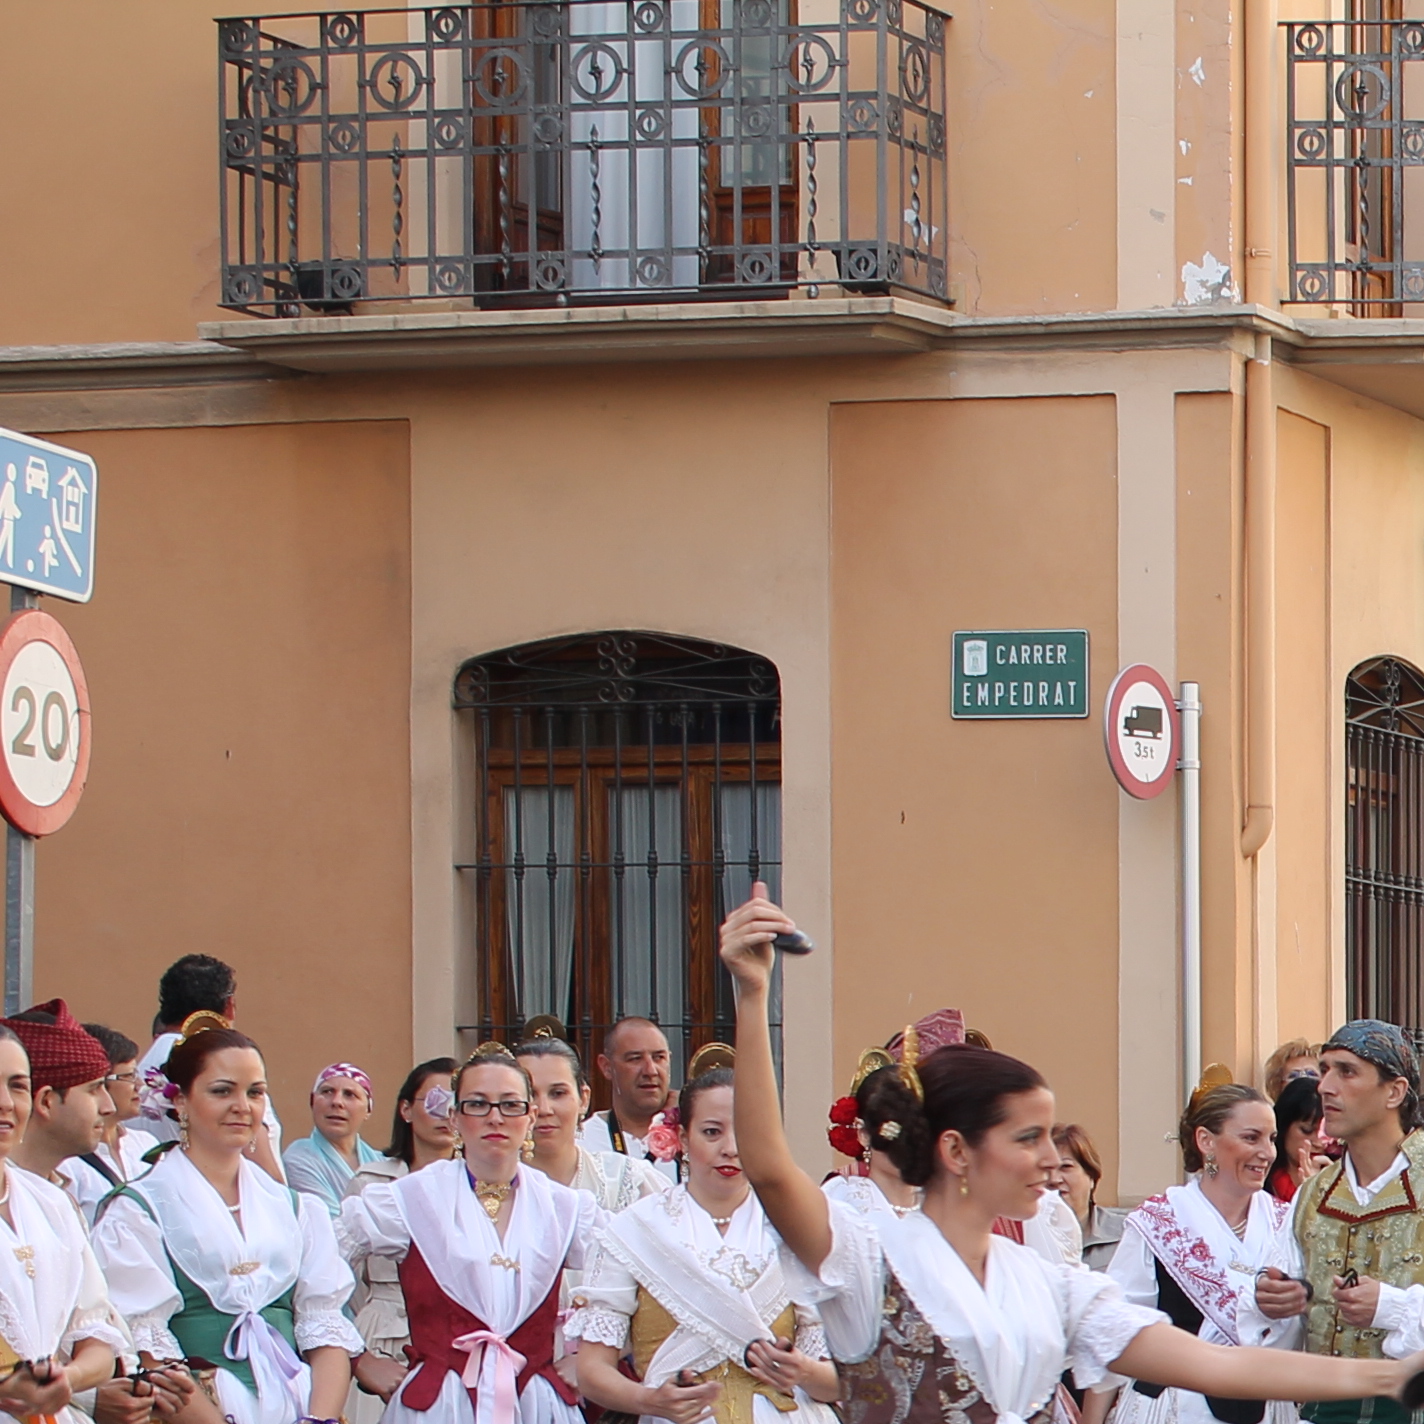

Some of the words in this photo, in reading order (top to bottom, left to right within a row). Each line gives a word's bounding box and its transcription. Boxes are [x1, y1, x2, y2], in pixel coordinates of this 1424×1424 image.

[995, 644, 1068, 666] CARRER
[962, 680, 1078, 708] EMPEDRAT
[11, 685, 70, 762] 20
